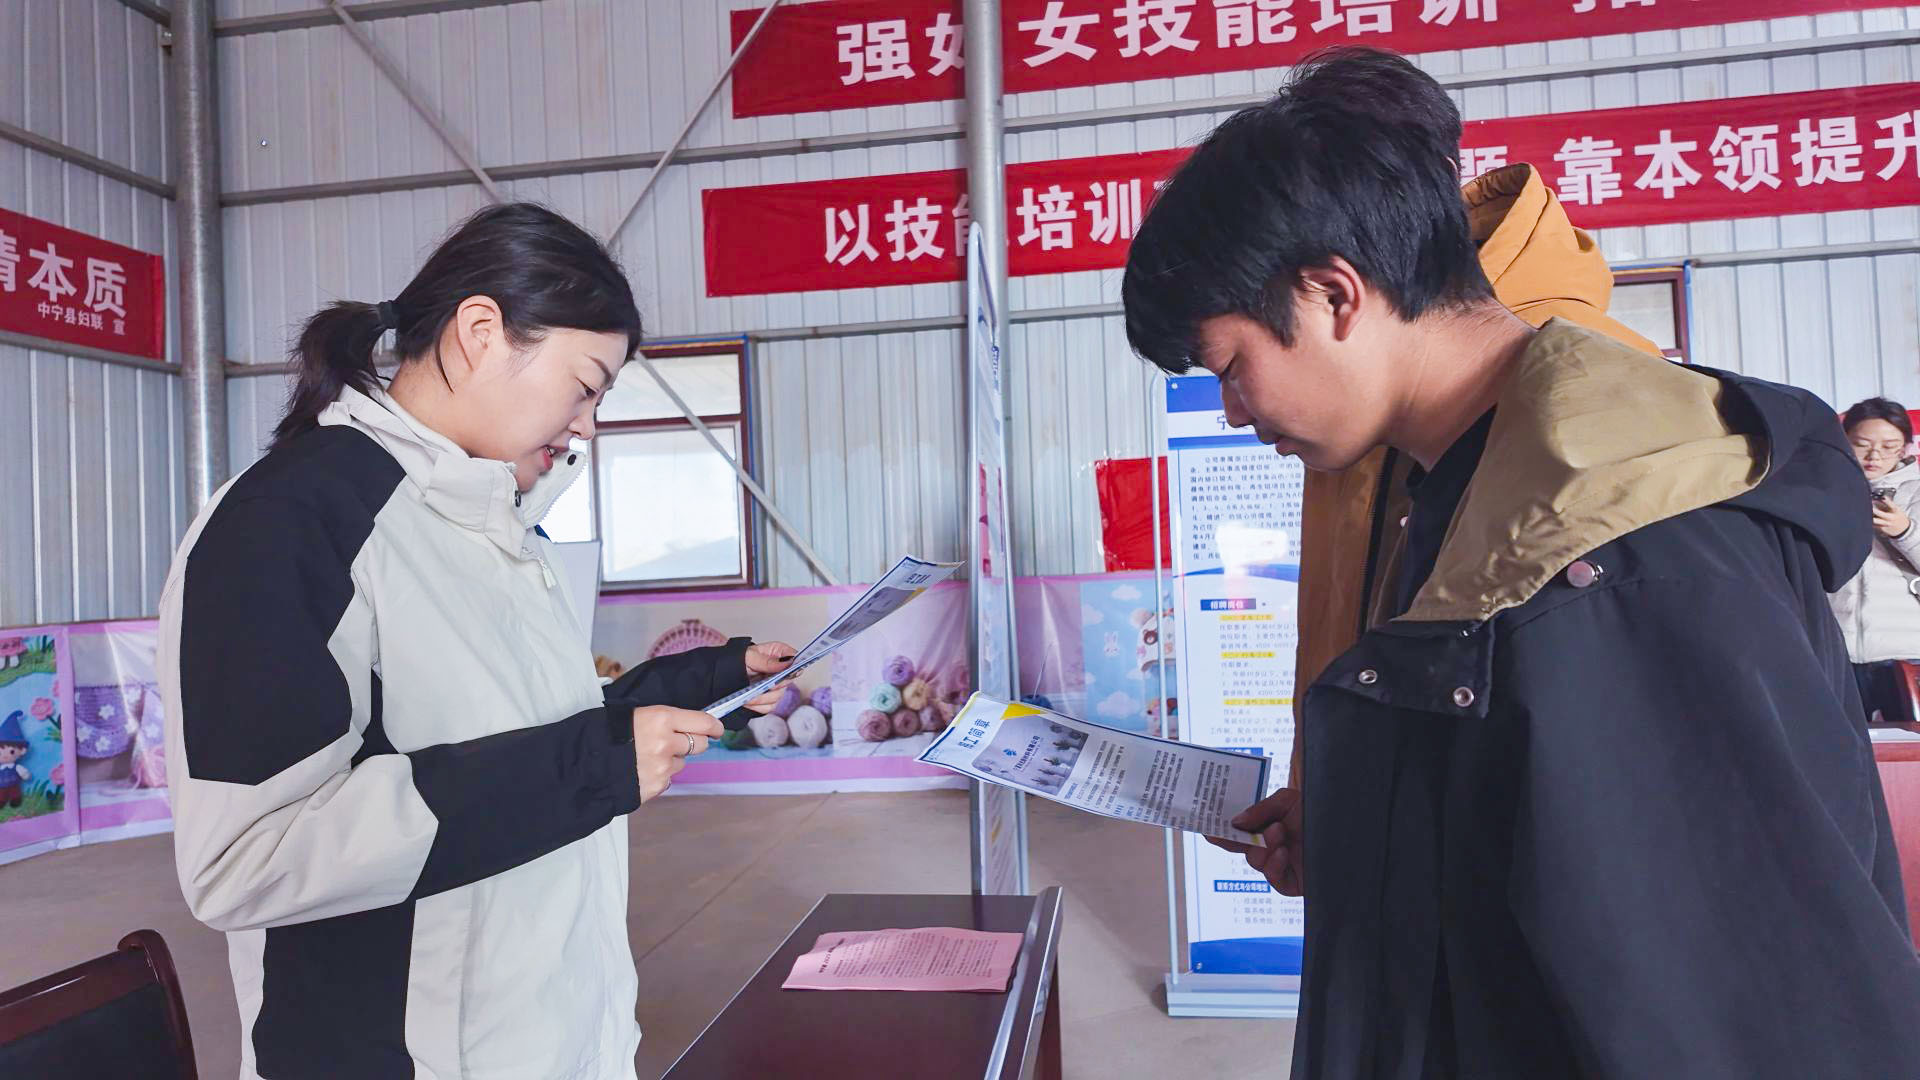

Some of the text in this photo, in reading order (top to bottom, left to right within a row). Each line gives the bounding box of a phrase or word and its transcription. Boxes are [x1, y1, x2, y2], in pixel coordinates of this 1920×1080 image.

[823, 177, 1172, 266] 以技培训
[1553, 109, 1920, 206] 靠本领提升
[37, 301, 104, 330] 中宁县妇联
